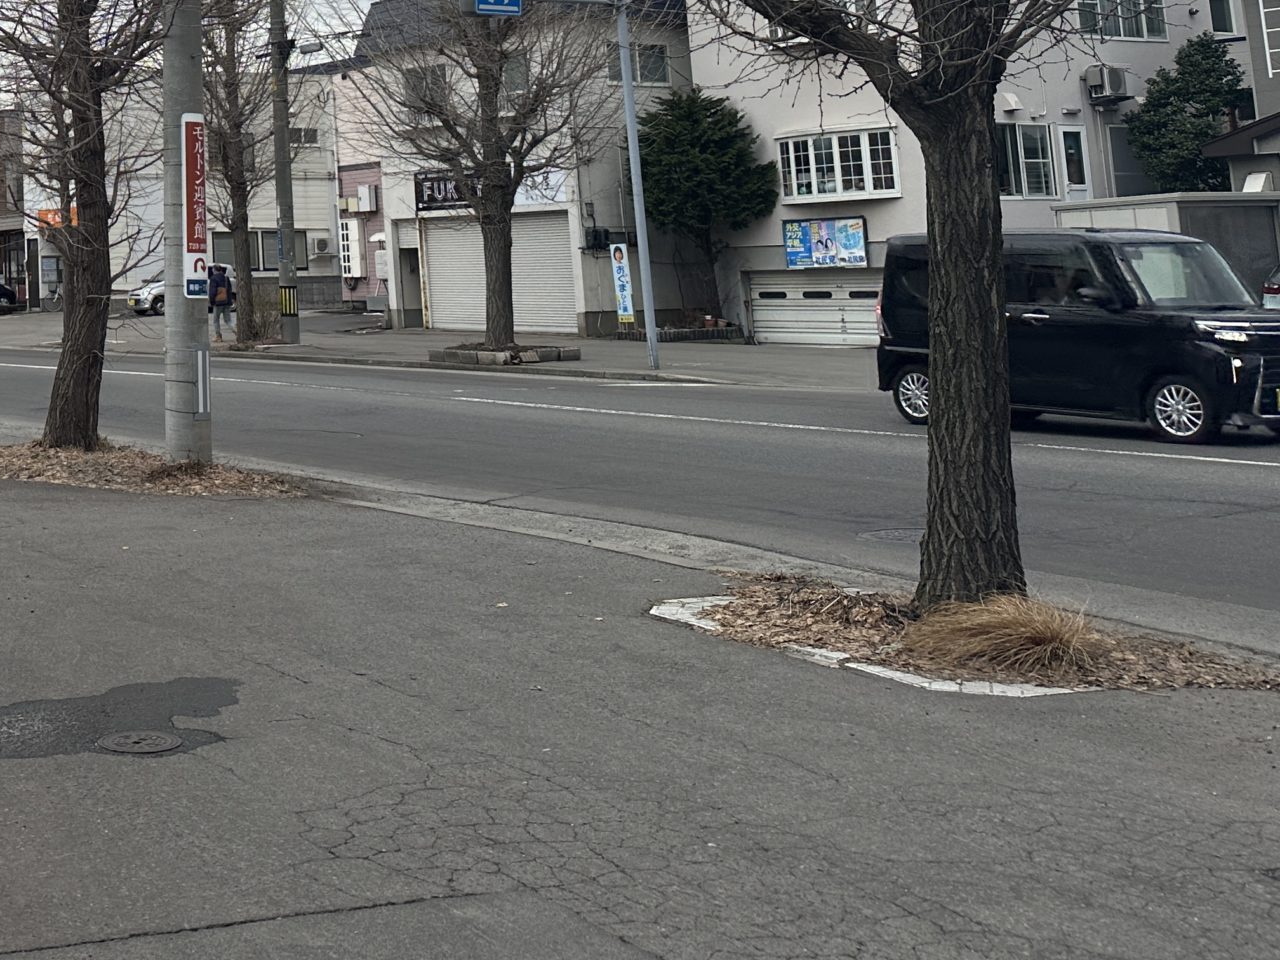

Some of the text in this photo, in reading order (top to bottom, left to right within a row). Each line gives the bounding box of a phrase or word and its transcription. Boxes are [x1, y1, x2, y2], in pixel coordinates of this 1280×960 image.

[192, 126, 206, 239] モルトン迎賓館
